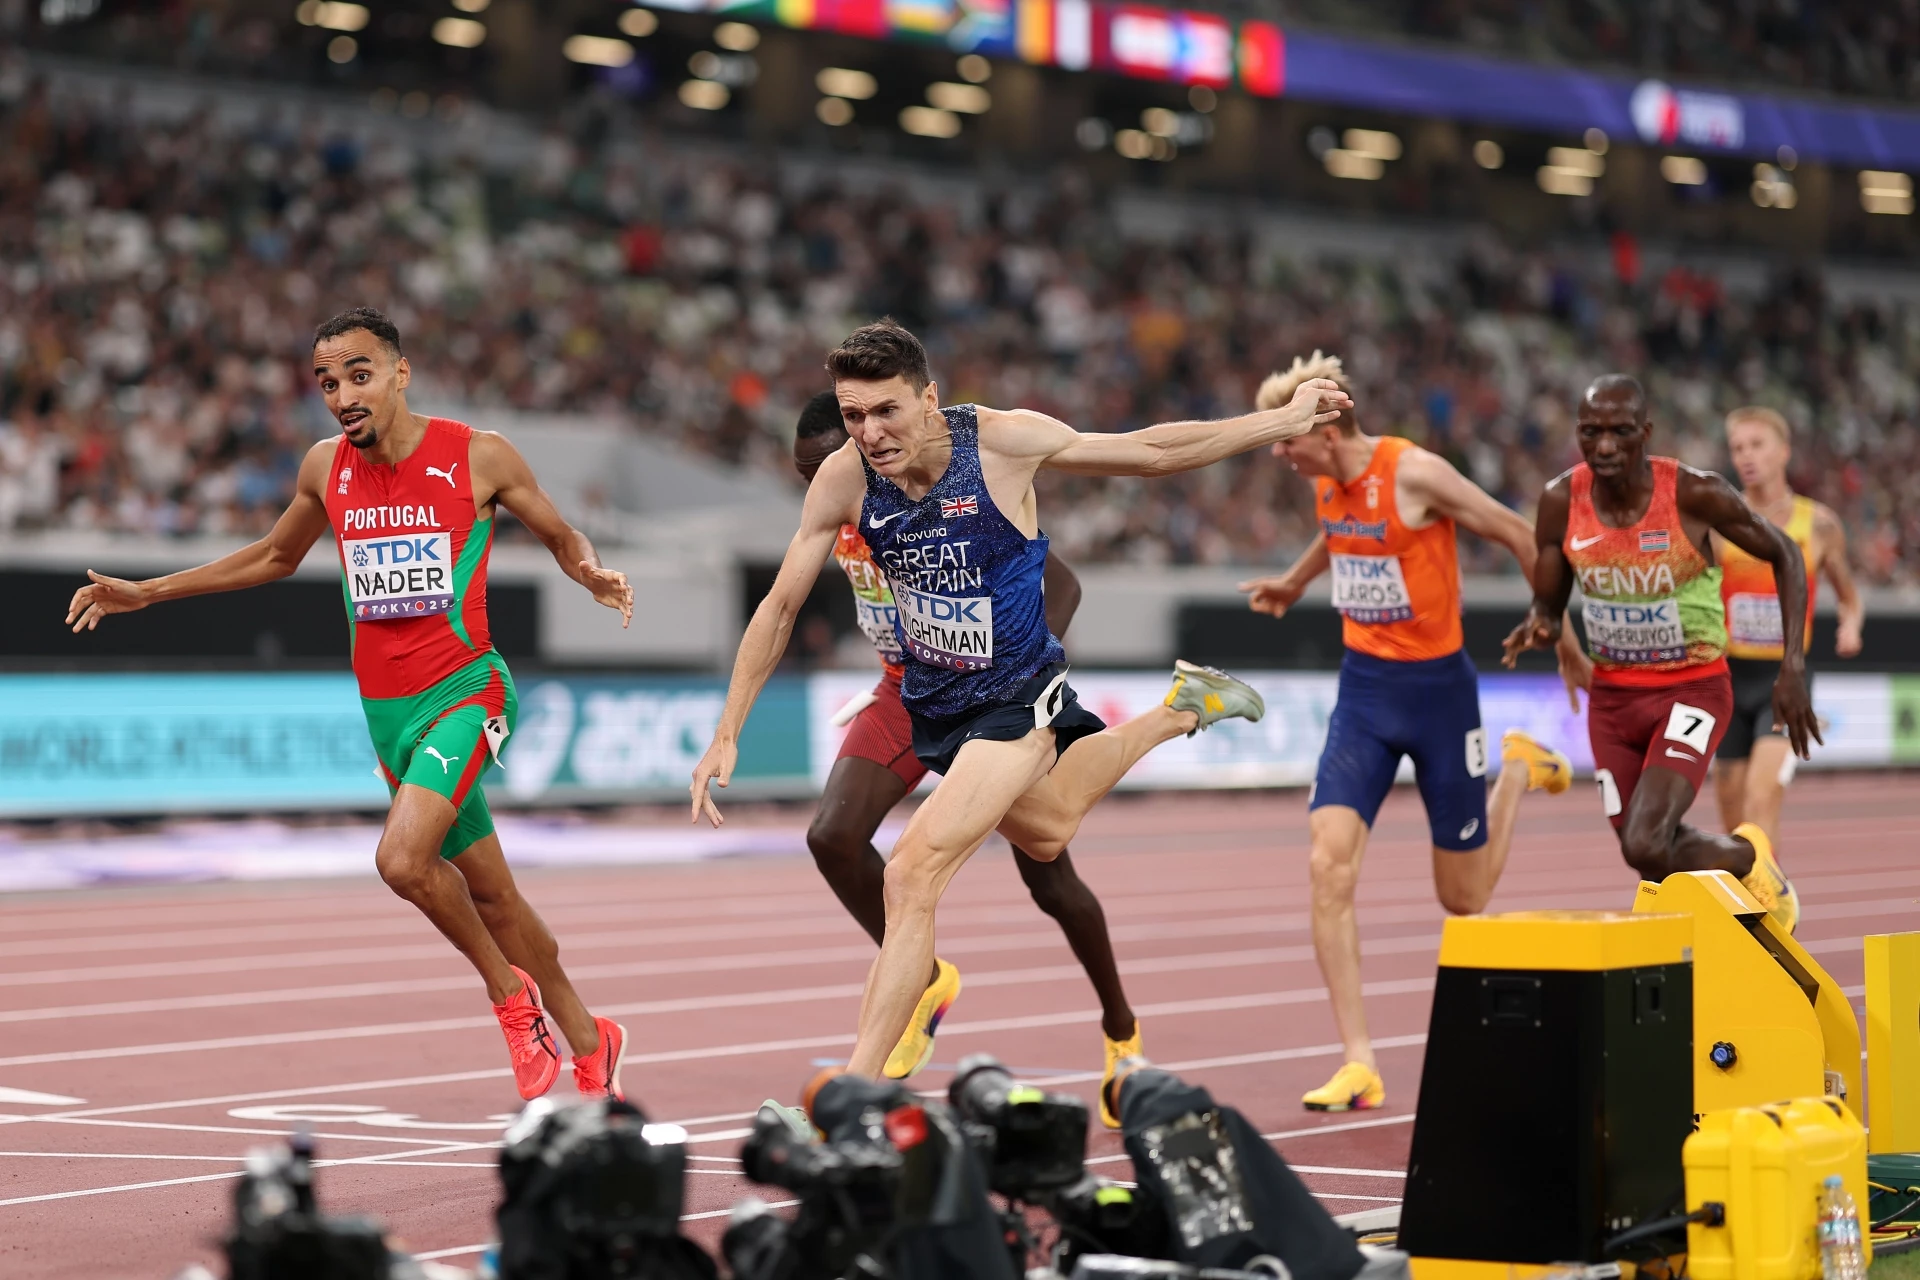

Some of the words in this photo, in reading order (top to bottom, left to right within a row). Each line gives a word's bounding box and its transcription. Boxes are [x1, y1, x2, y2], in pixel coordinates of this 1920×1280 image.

[344, 505, 441, 531] PORTUGAL
[896, 527, 948, 544] Novuna
[367, 538, 441, 566] TDK
[881, 541, 971, 570] GREAT
[1347, 558, 1394, 579] TDK
[1576, 562, 1676, 596] KENYA
[355, 567, 445, 597] NADER
[1337, 582, 1403, 605] LAROS
[909, 590, 983, 624] TDK
[1603, 604, 1670, 624] TDK
[1684, 713, 1703, 736] 7
